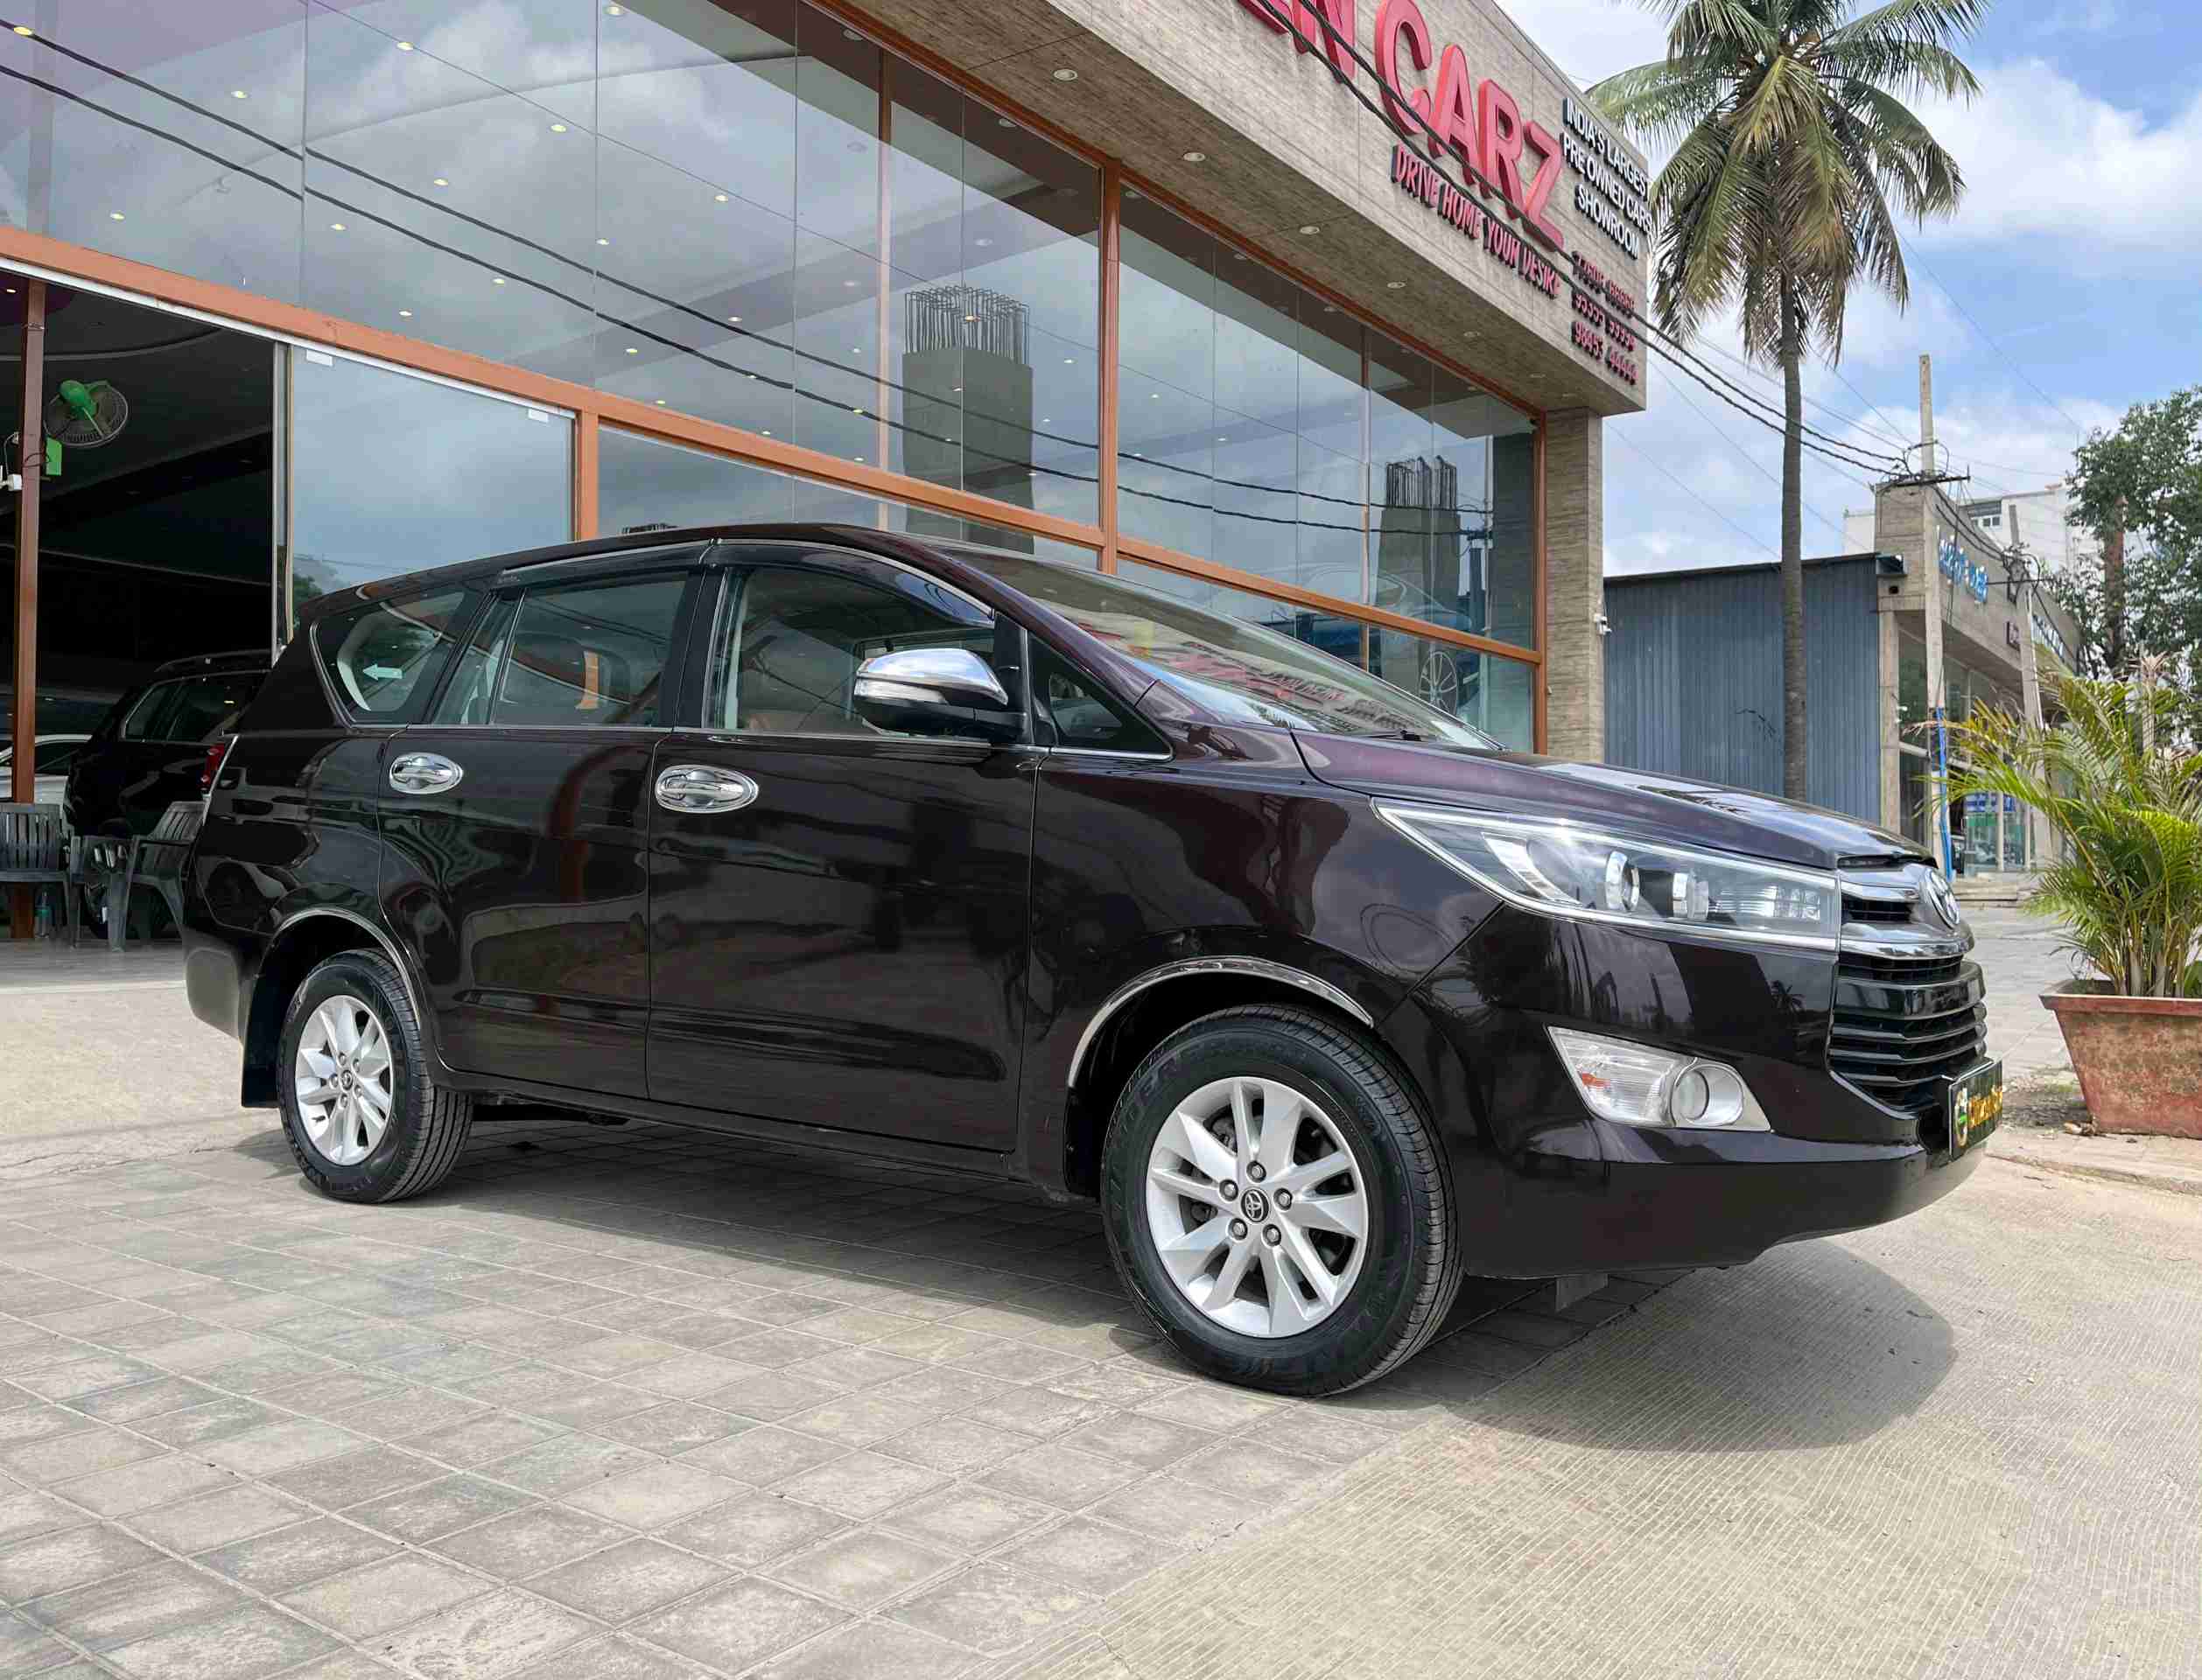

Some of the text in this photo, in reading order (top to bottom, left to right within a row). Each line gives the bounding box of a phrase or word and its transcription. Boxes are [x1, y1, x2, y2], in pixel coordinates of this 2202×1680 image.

[1375, 0, 1564, 252] CARZ
[1563, 97, 1605, 155] INDIA'S
[1391, 144, 1438, 209] DRIVE
[1437, 182, 1482, 240] HOME
[1483, 216, 1521, 269] YOUR
[1518, 242, 1562, 299] DESIRE
[1561, 131, 1653, 236] PRE OWNED CARS
[1576, 184, 1639, 260] SHOWROOM
